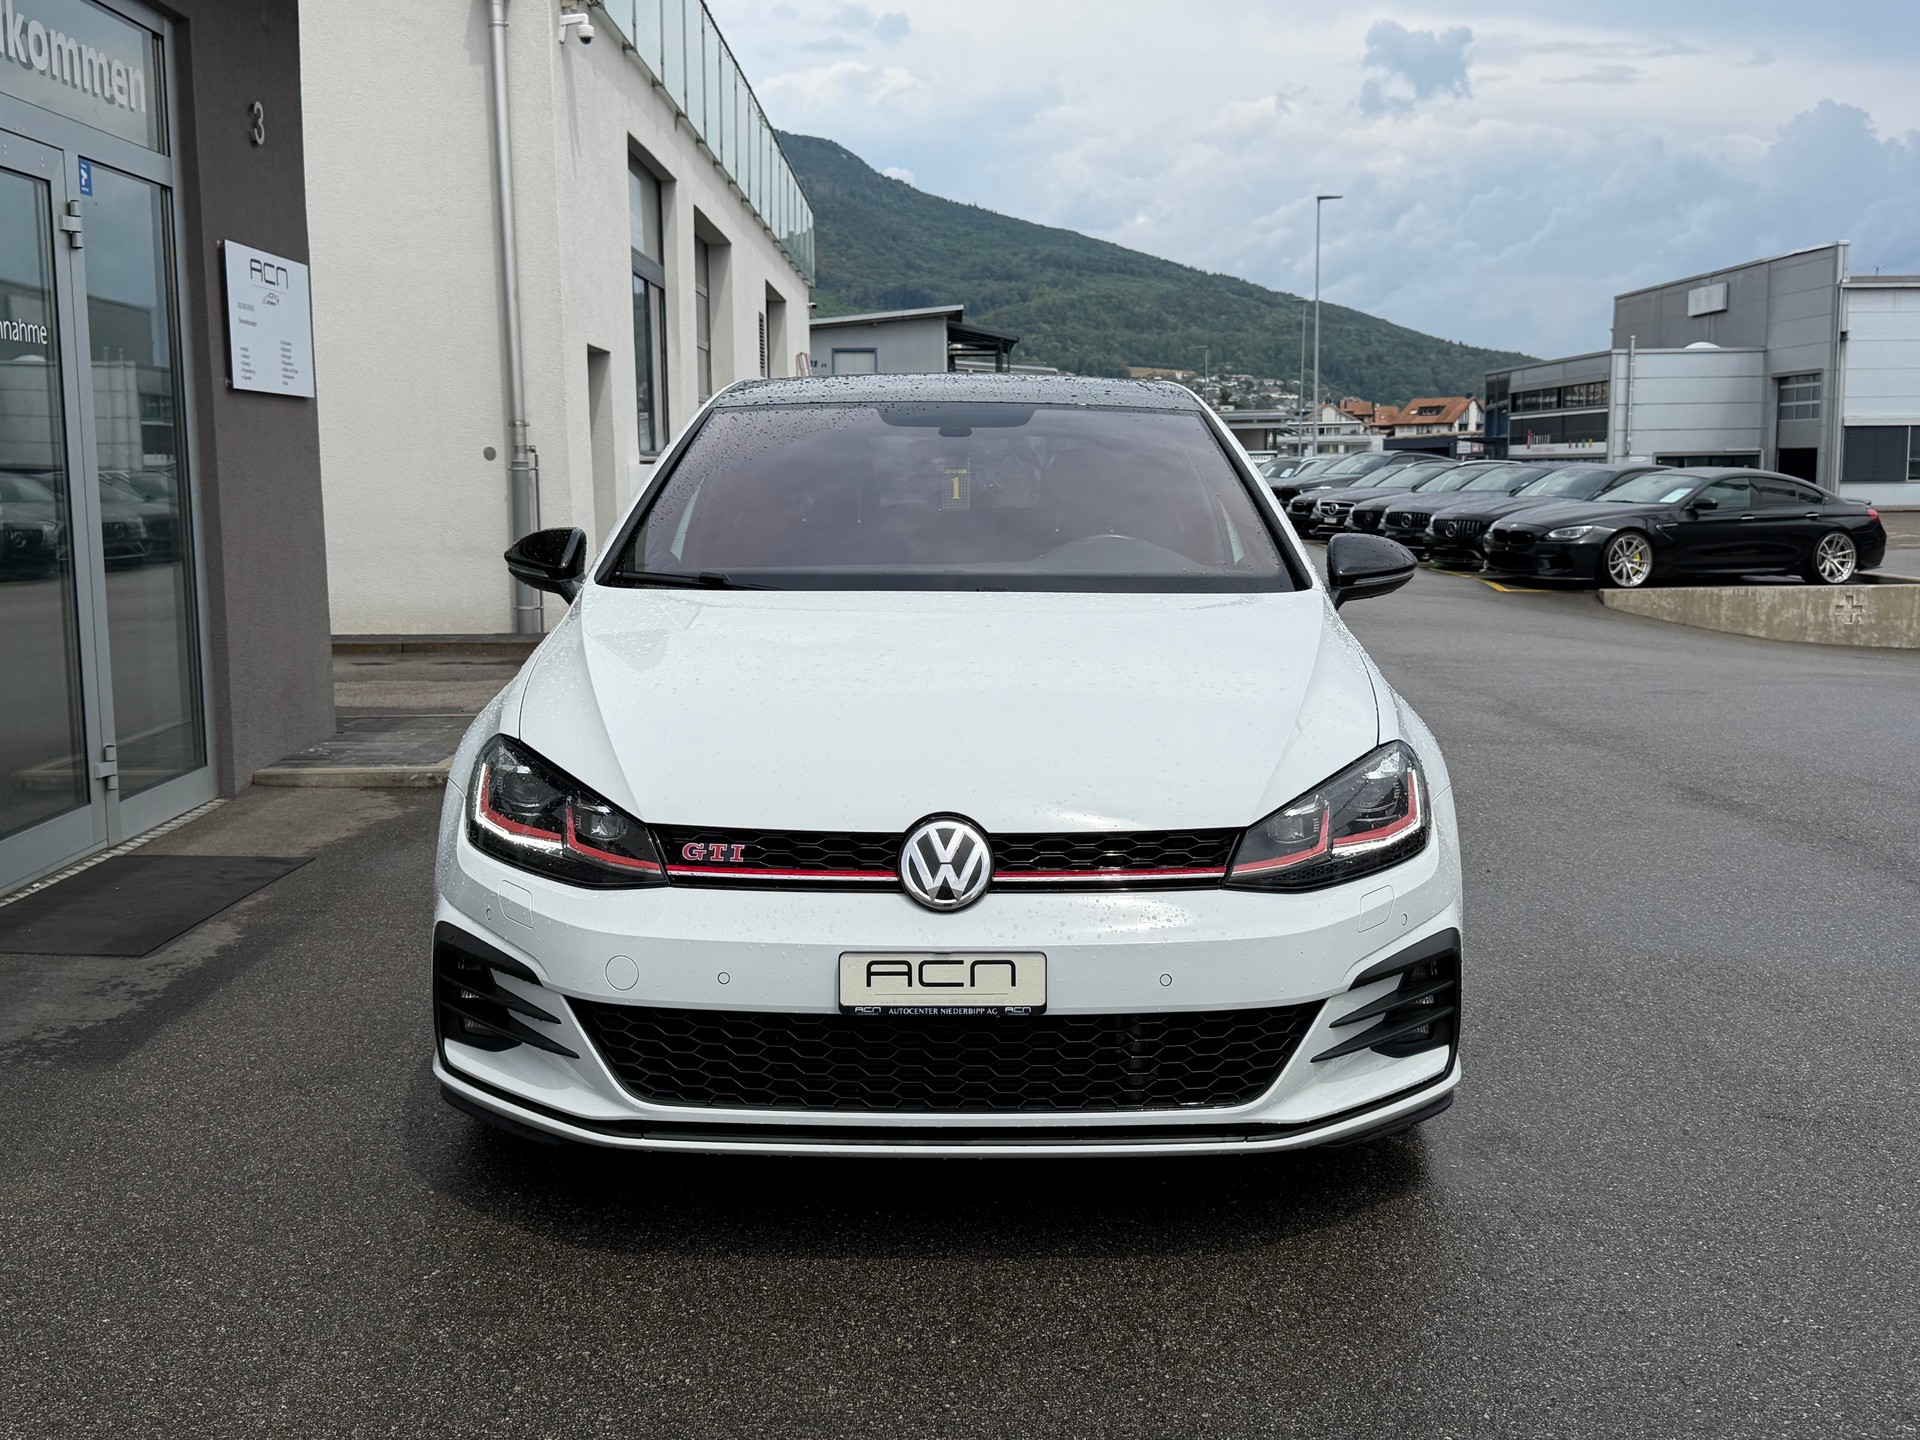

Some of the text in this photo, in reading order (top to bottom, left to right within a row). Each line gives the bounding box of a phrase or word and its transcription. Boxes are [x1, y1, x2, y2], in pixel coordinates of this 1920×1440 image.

[252, 101, 265, 145] 3
[951, 476, 961, 499] 1
[682, 842, 746, 863] GTI
[904, 822, 988, 905] VW
[866, 959, 1016, 987] ACN
[888, 1007, 939, 1015] AUTOCENTER
[940, 1007, 986, 1015] NIEDERBIPP
[987, 1007, 998, 1015] AG
